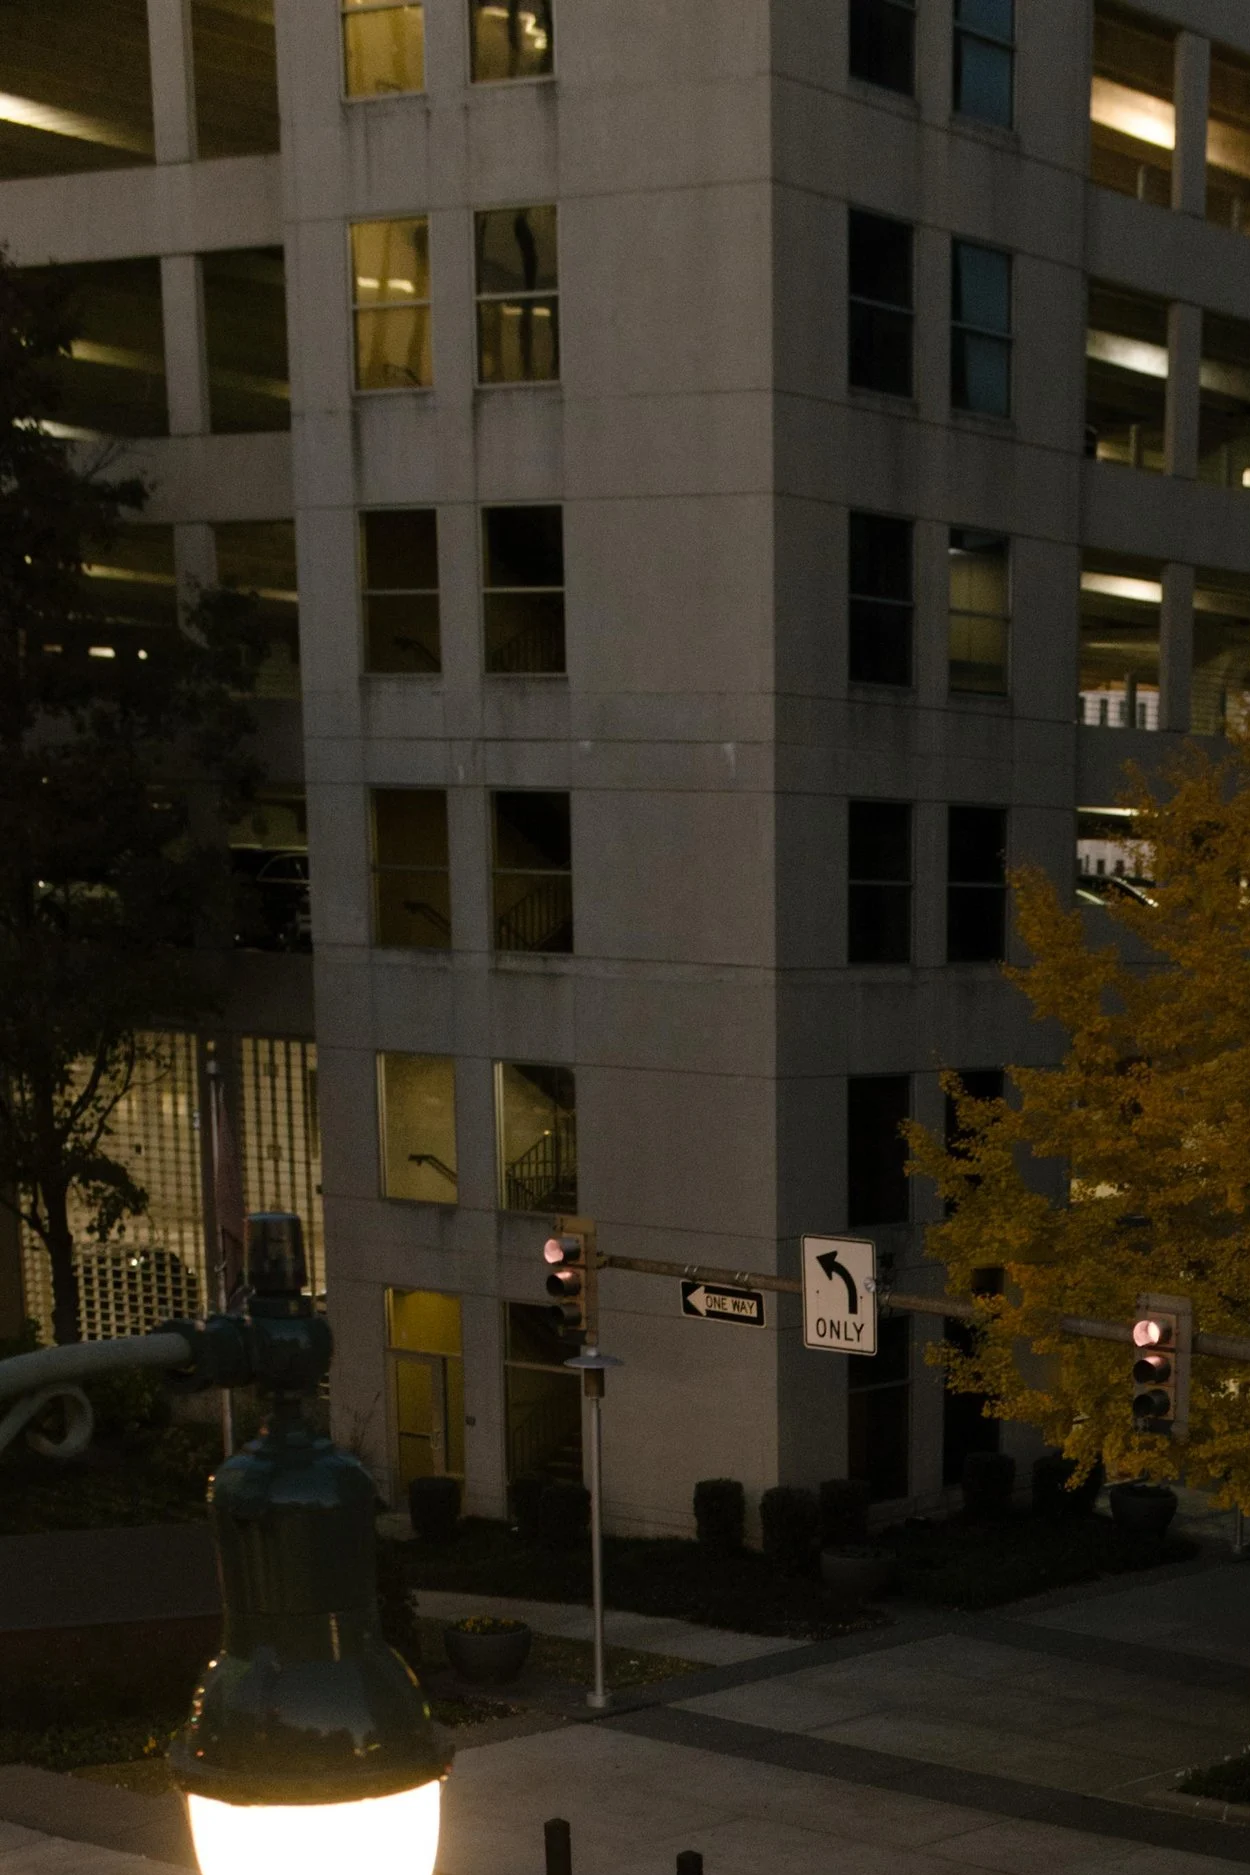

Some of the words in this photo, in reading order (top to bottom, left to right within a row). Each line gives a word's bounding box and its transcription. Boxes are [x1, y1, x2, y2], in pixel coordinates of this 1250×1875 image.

[705, 1295, 727, 1311] ONE
[731, 1299, 756, 1315] WAY
[815, 1318, 865, 1343] ONLY
